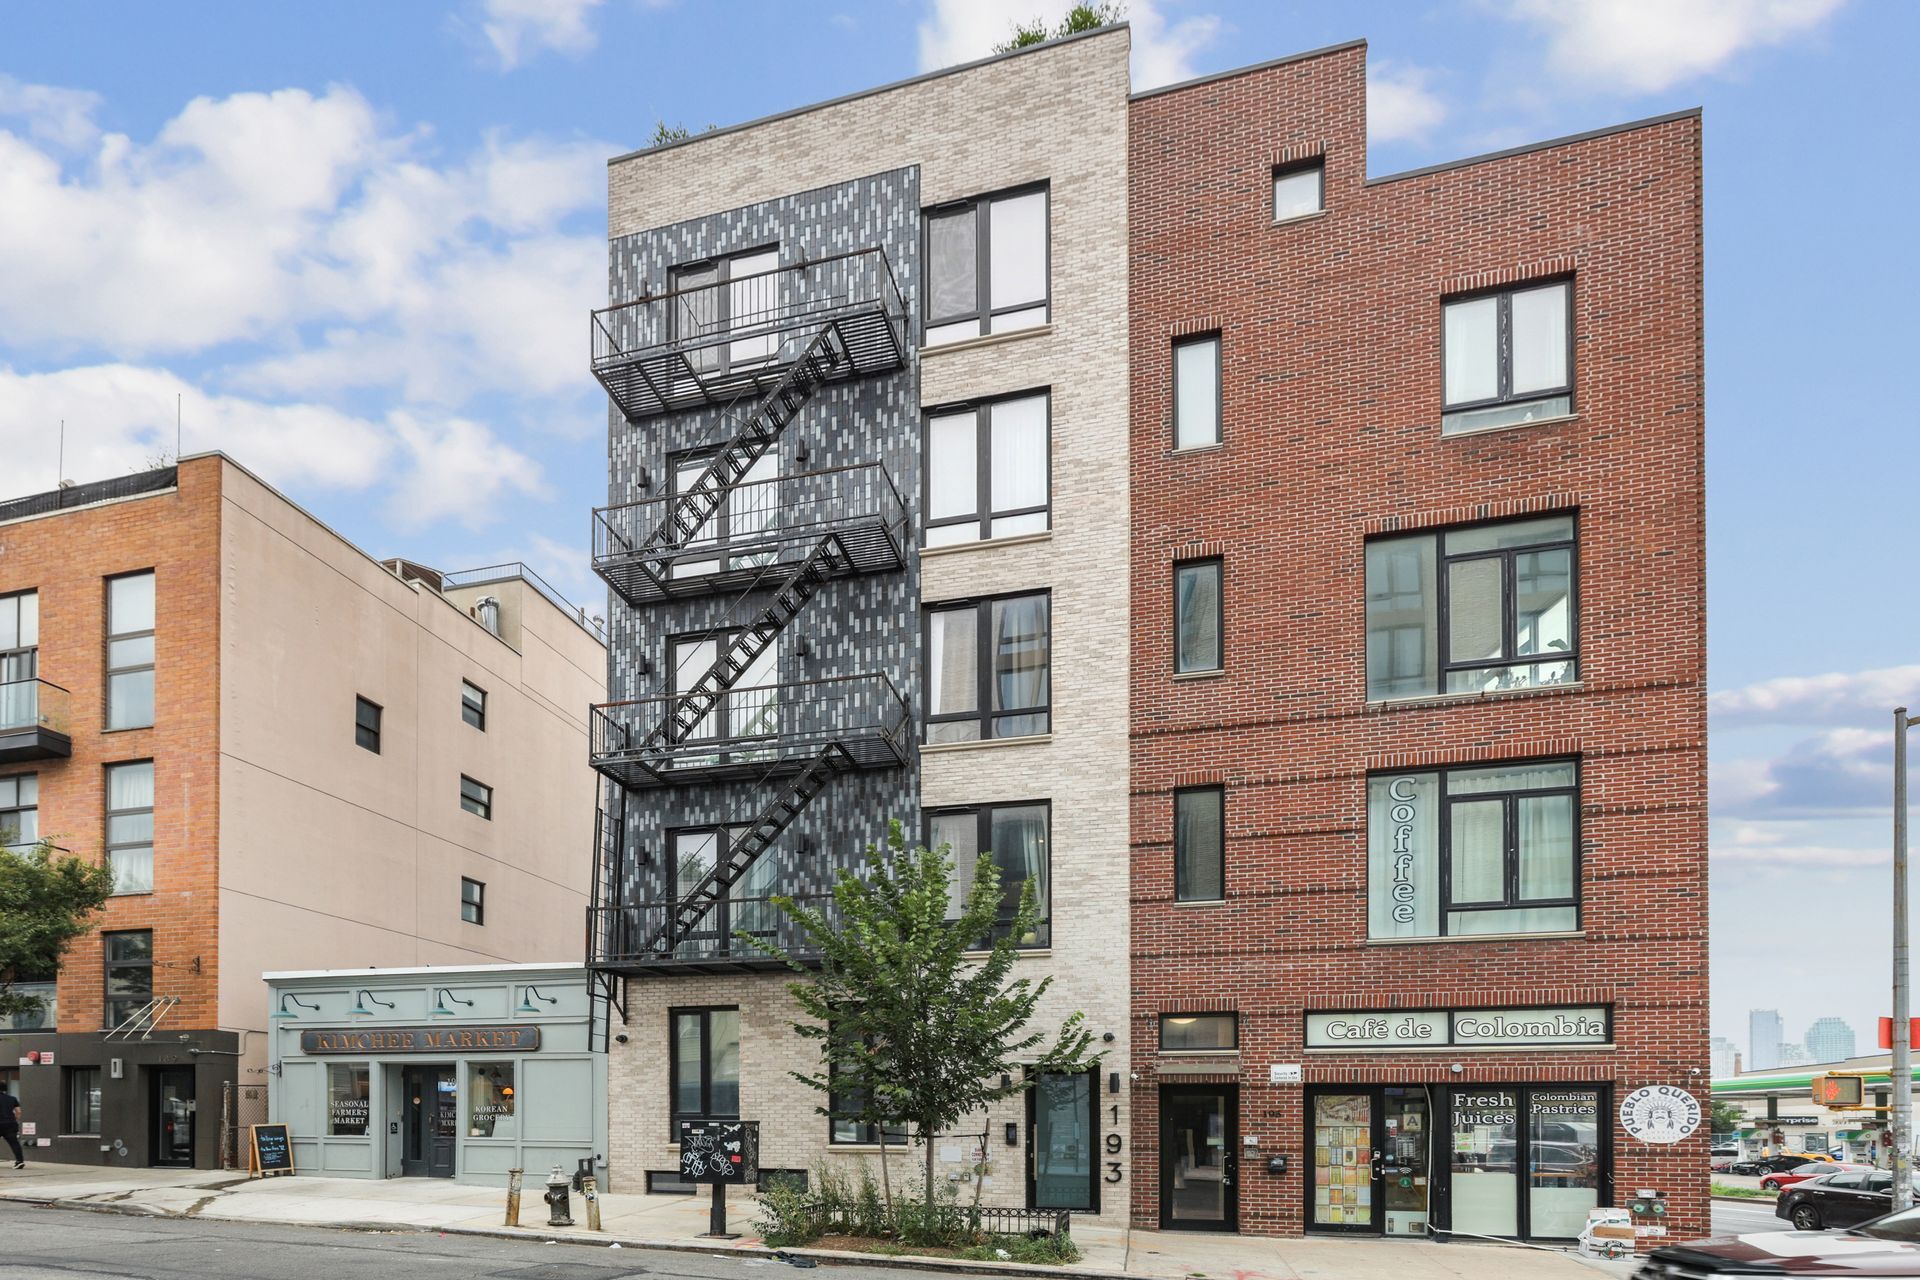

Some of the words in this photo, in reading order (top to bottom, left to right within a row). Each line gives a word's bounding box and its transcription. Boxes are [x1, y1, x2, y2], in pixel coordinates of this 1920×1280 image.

[1388, 776, 1417, 924] Coffee
[1326, 1018, 1389, 1039] Café
[1395, 1017, 1432, 1039] de
[1455, 1014, 1606, 1038] Colombia
[317, 1033, 414, 1049] KIMCHEE
[425, 1031, 521, 1048] MARKET
[331, 1100, 369, 1108] SEASONAL
[1453, 1092, 1515, 1107] Fresh
[1531, 1092, 1596, 1102] Colombian
[331, 1108, 368, 1116] FARMER'S
[475, 1105, 508, 1113] KOREAN
[1531, 1103, 1596, 1114] Pastries
[1622, 1089, 1651, 1134] PUEBLO
[1658, 1086, 1699, 1134] QUERIDO
[1453, 1111, 1516, 1127] Juices
[1105, 1104, 1123, 1183] 193
